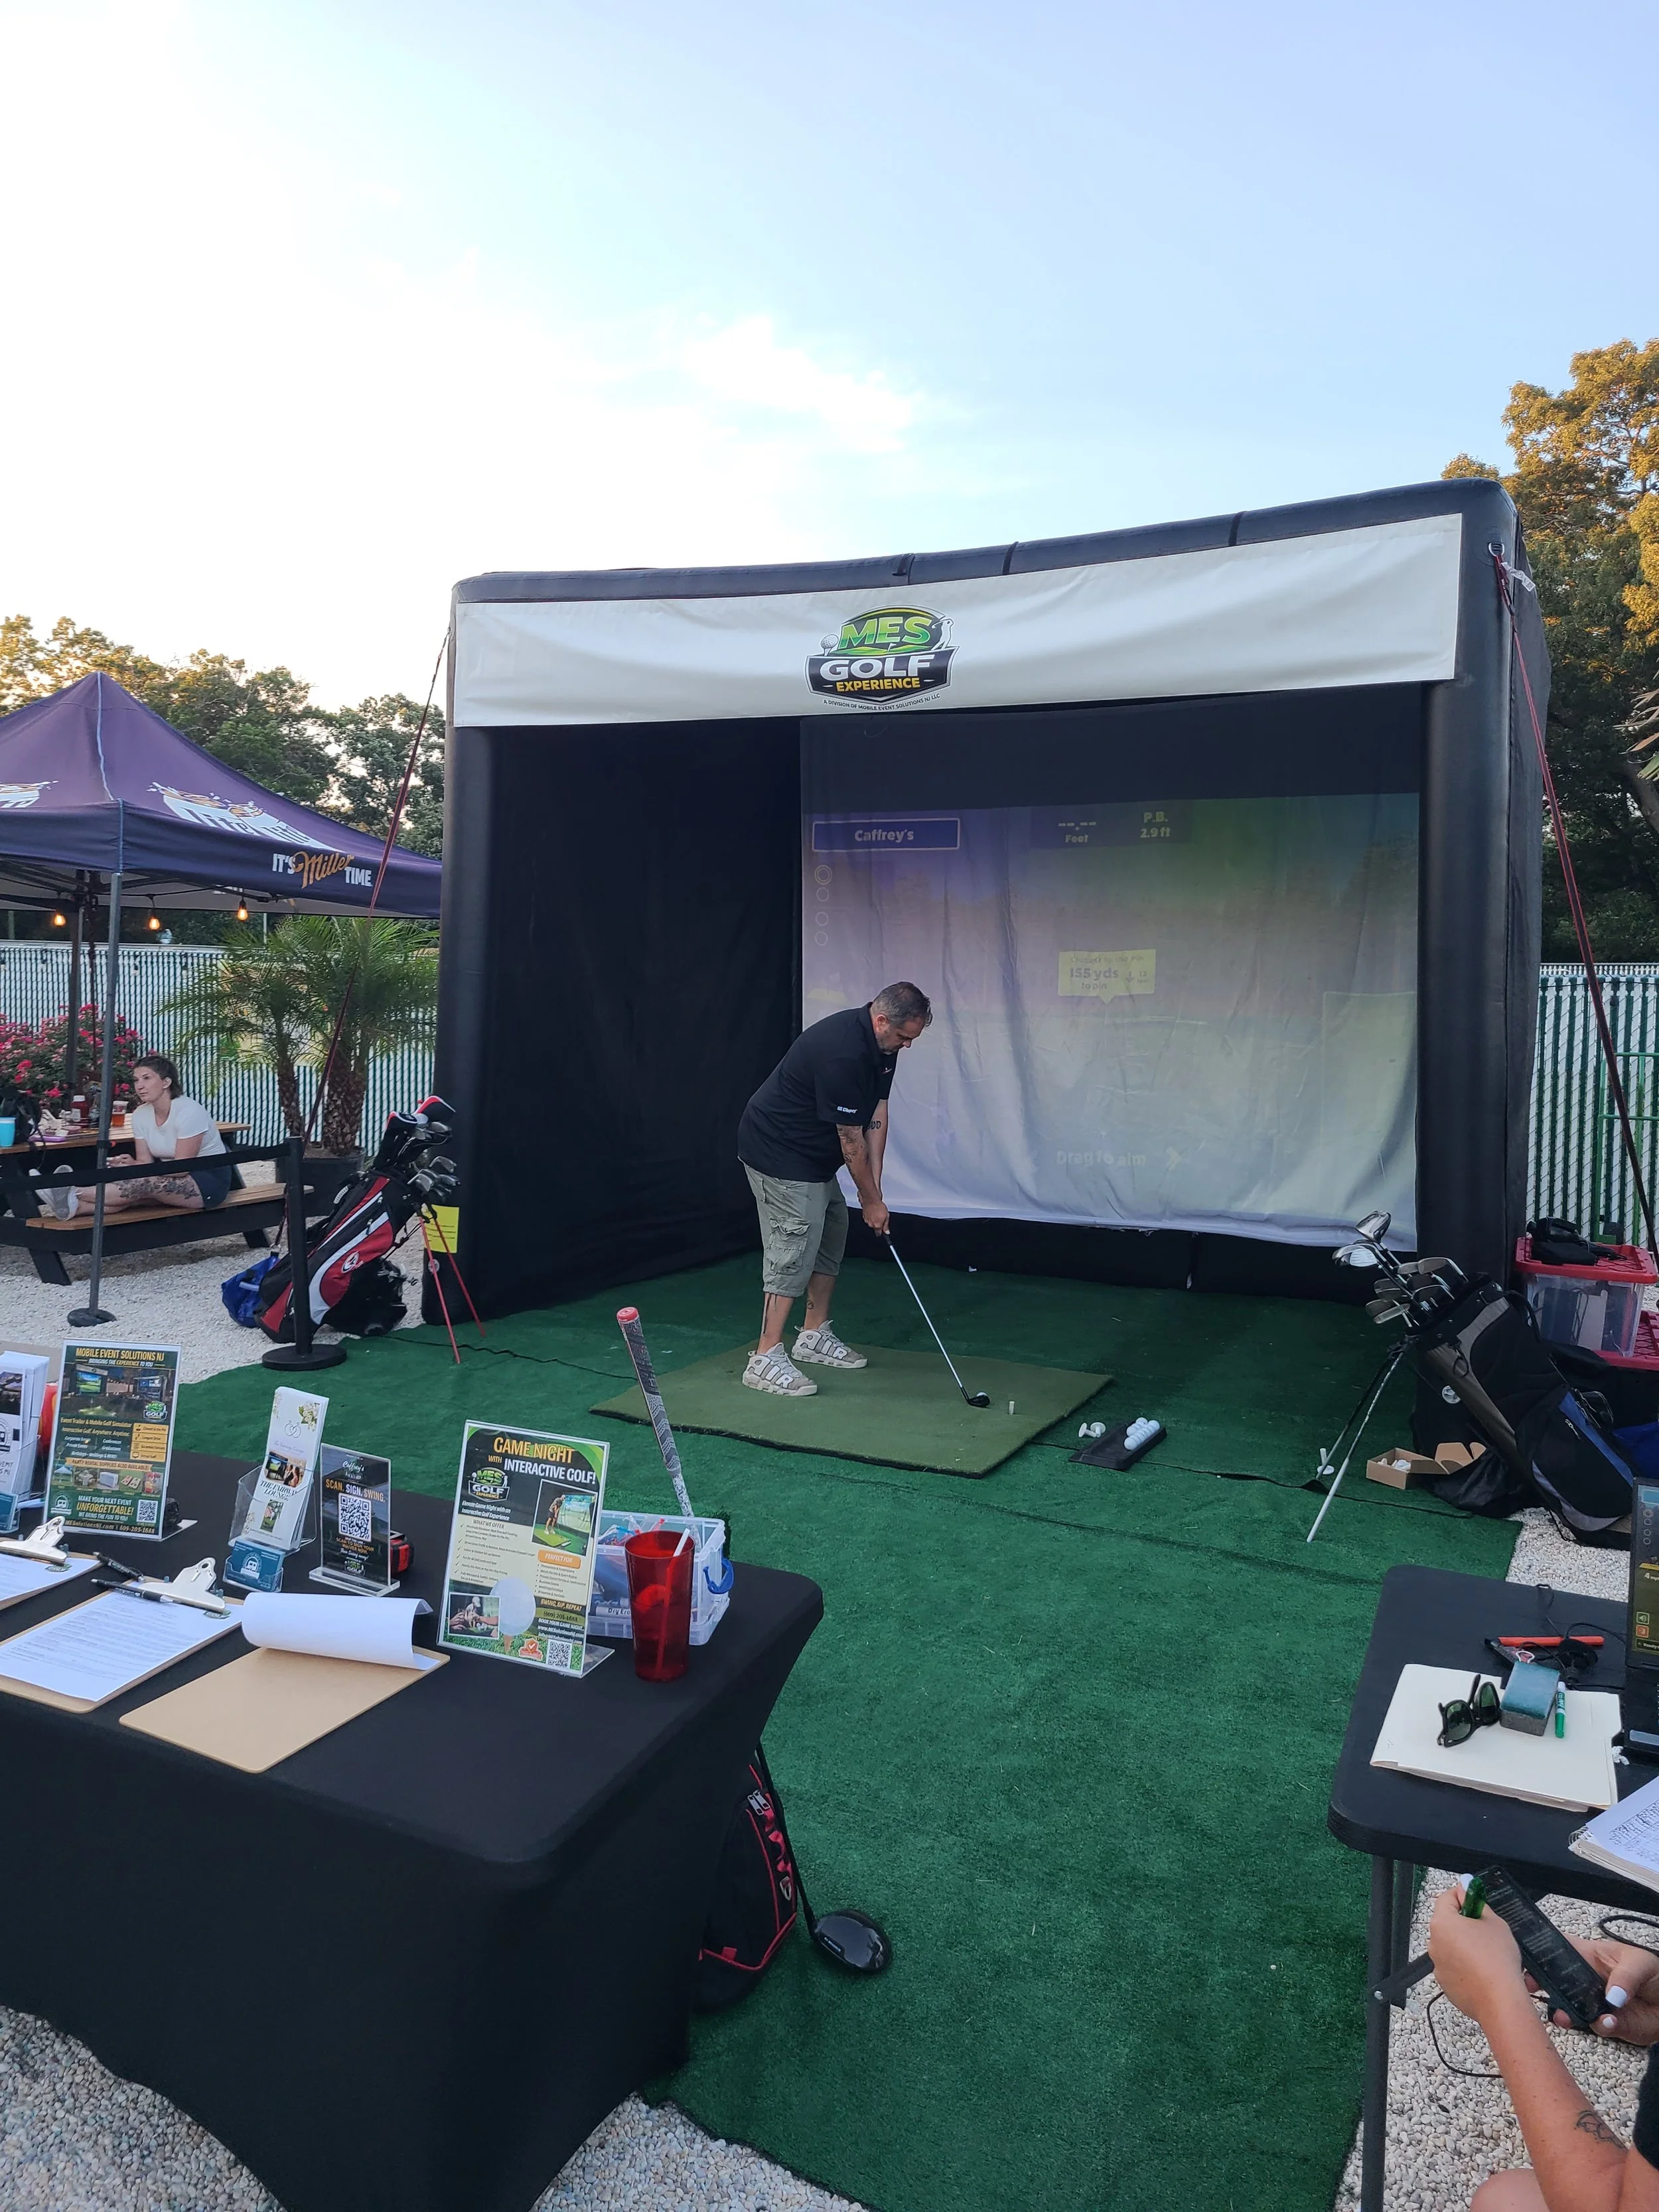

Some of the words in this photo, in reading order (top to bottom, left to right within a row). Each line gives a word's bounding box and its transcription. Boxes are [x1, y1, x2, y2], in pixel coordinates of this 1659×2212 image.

[838, 617, 932, 649] MES
[820, 654, 934, 681] GOLF
[836, 678, 920, 692] EXPERIENCE
[896, 698, 924, 709] SOLUTIONS
[1143, 811, 1168, 823] P.B.
[854, 829, 914, 843] Caffrey's
[1065, 834, 1088, 843] Feet
[1140, 828, 1157, 838] 2.9
[1159, 827, 1170, 837] ft
[272, 853, 295, 874] IT'S
[292, 851, 354, 889] Miller
[344, 867, 373, 887] TIME
[1070, 968, 1091, 978] 155
[1094, 968, 1119, 980] yds
[1057, 1151, 1094, 1166] Drag
[1096, 1150, 1114, 1165] to
[1118, 1153, 1146, 1166] aim
[798, 1330, 848, 1359] AIR
[76, 1348, 99, 1357] MOBILE
[100, 1349, 119, 1358] EVENT
[121, 1351, 156, 1360] SOLUTIONS
[748, 1356, 794, 1388] AIR
[494, 1437, 530, 1457] GAME
[533, 1444, 575, 1463] NIGHT
[342, 1460, 364, 1473] Caffrey's
[488, 1455, 502, 1463] WITH
[504, 1459, 565, 1479] INTERACTIVE
[567, 1468, 597, 1485] GOLF!
[476, 1469, 502, 1482] MES
[326, 1479, 344, 1491] SCAN.
[346, 1484, 363, 1497] SIGN.
[364, 1488, 386, 1503] SWING.
[472, 1484, 504, 1495] GOLF
[76, 1502, 134, 1515] UNFORGETTABLE!
[489, 1512, 510, 1520] Experience
